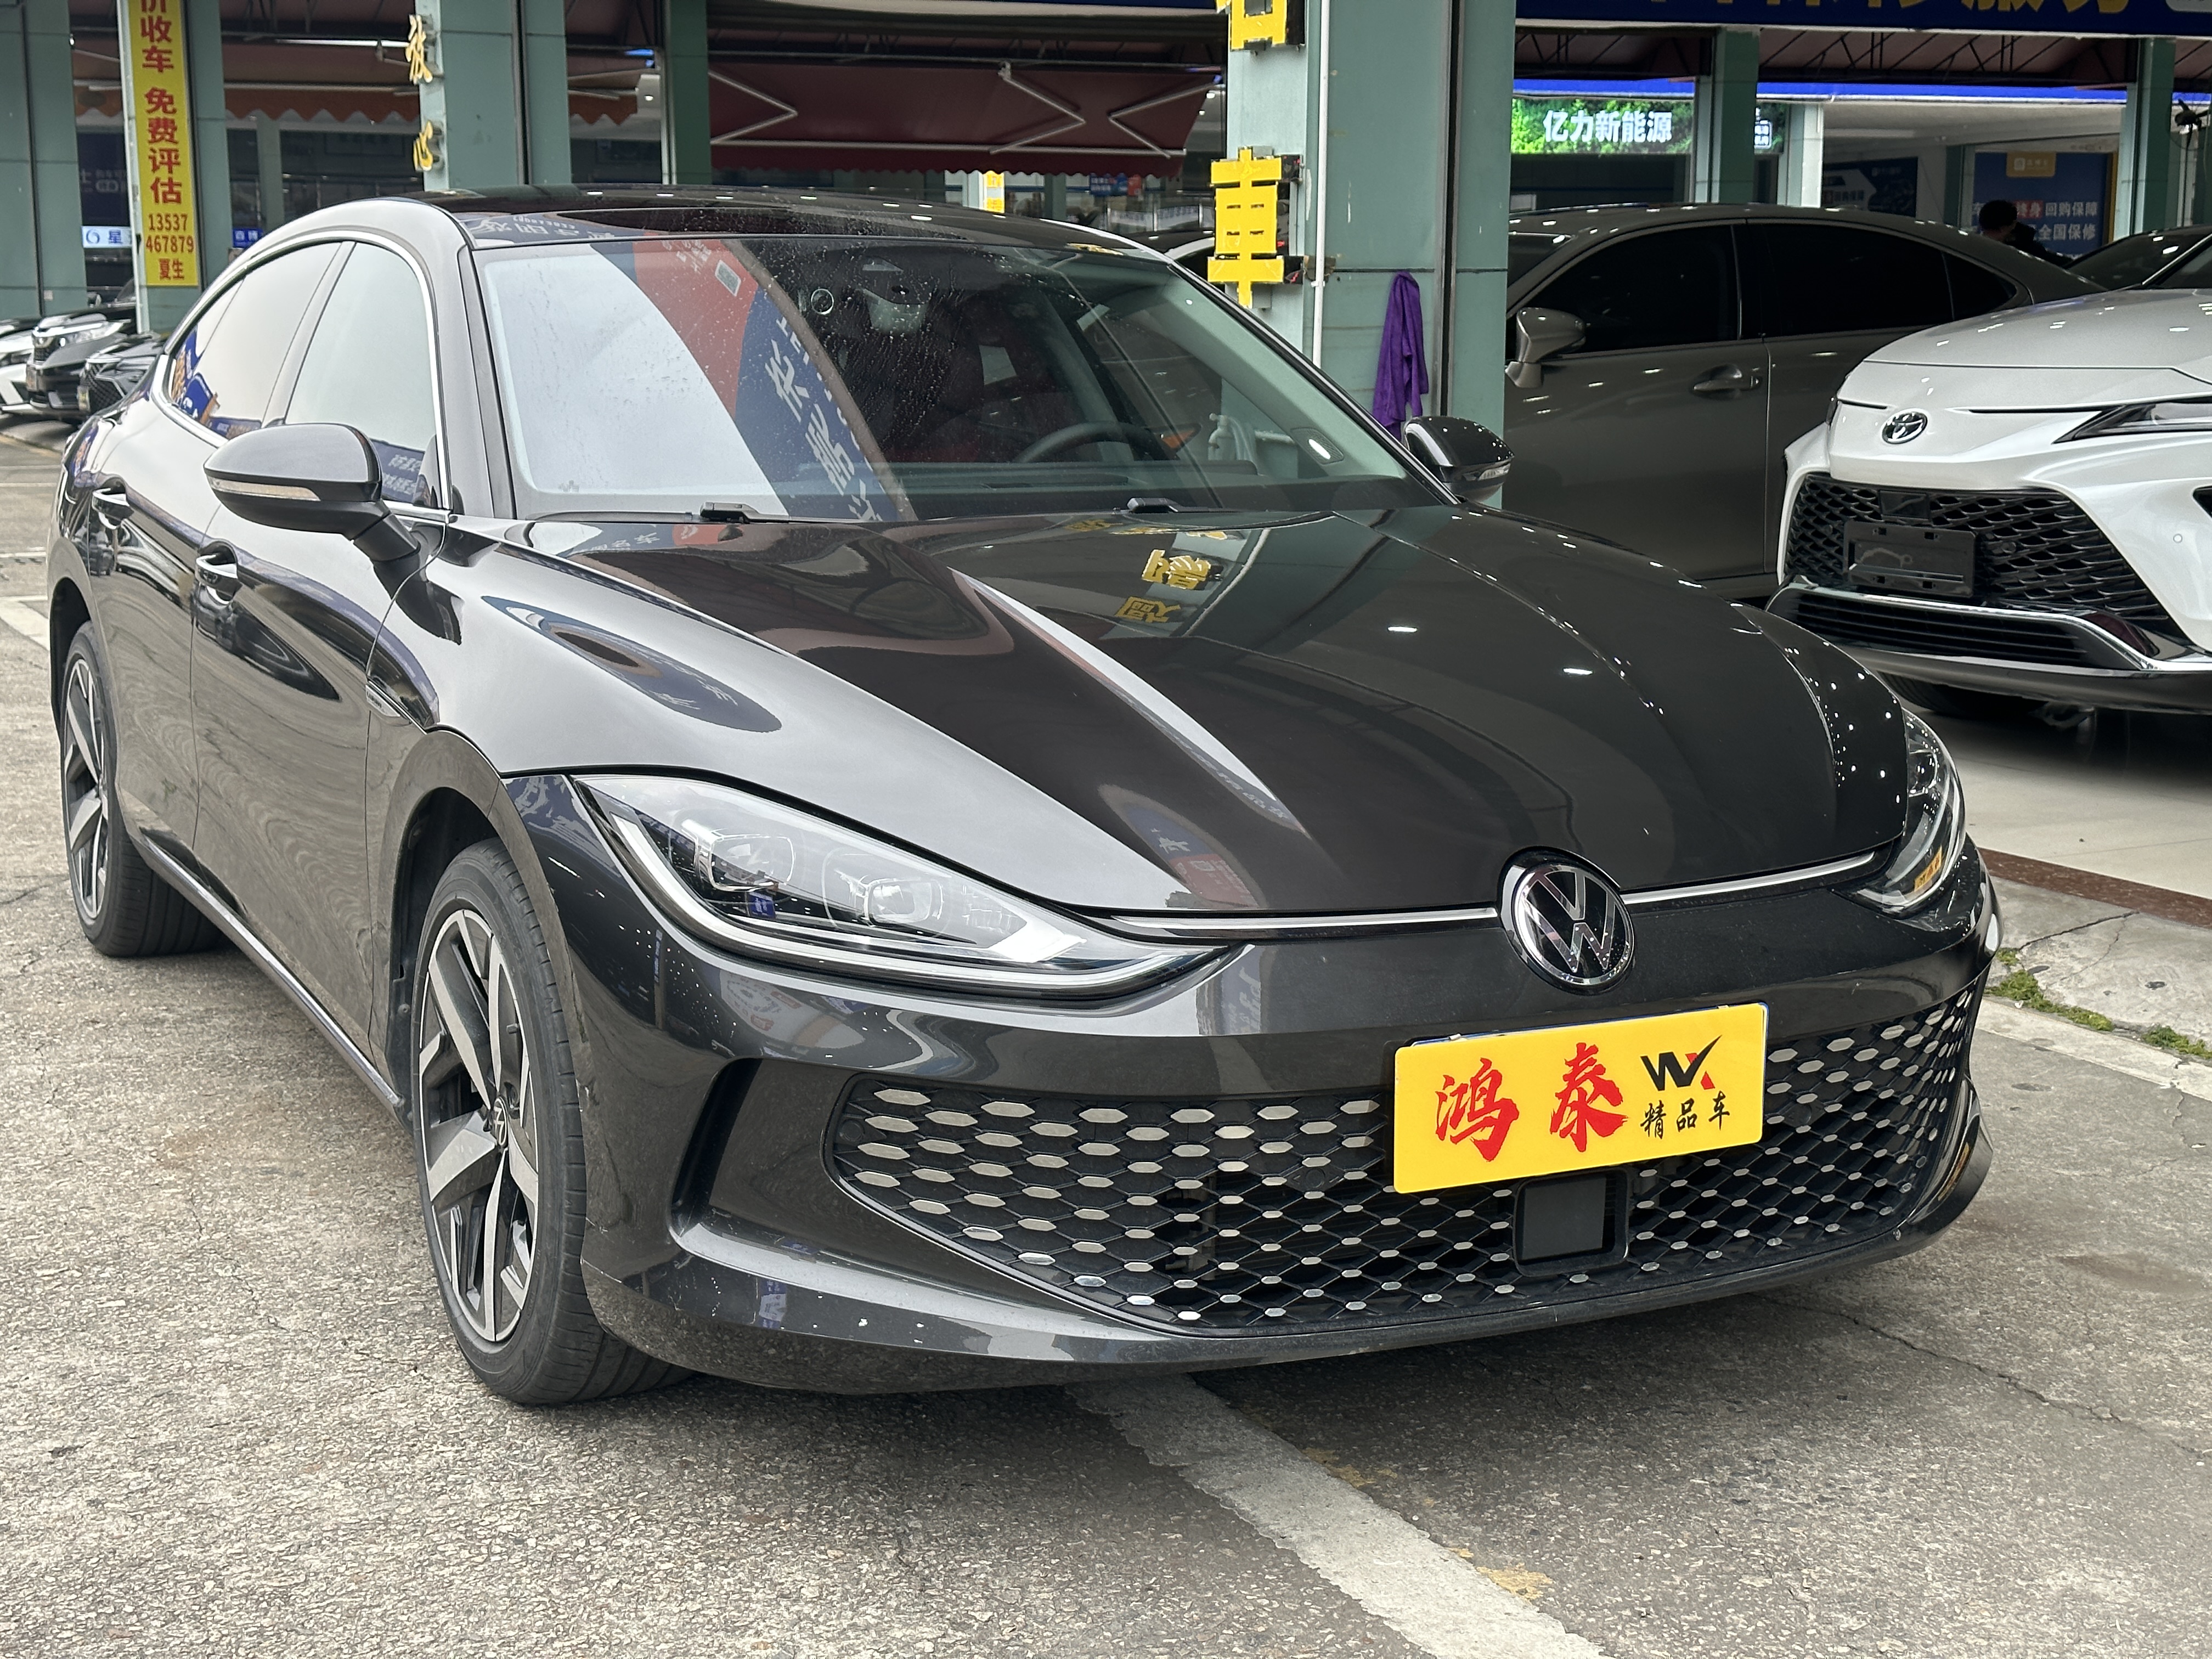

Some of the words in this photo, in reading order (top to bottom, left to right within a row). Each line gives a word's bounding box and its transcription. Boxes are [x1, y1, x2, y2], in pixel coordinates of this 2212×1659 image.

[1543, 109, 1673, 143] 亿力新能源
[145, 87, 182, 204] 免费评估
[148, 212, 188, 232] 13537
[145, 235, 194, 253] 467879
[159, 257, 184, 280] 夏生
[1434, 1041, 1629, 1162] 鸿泰
[1639, 1091, 1731, 1140] 精品车
